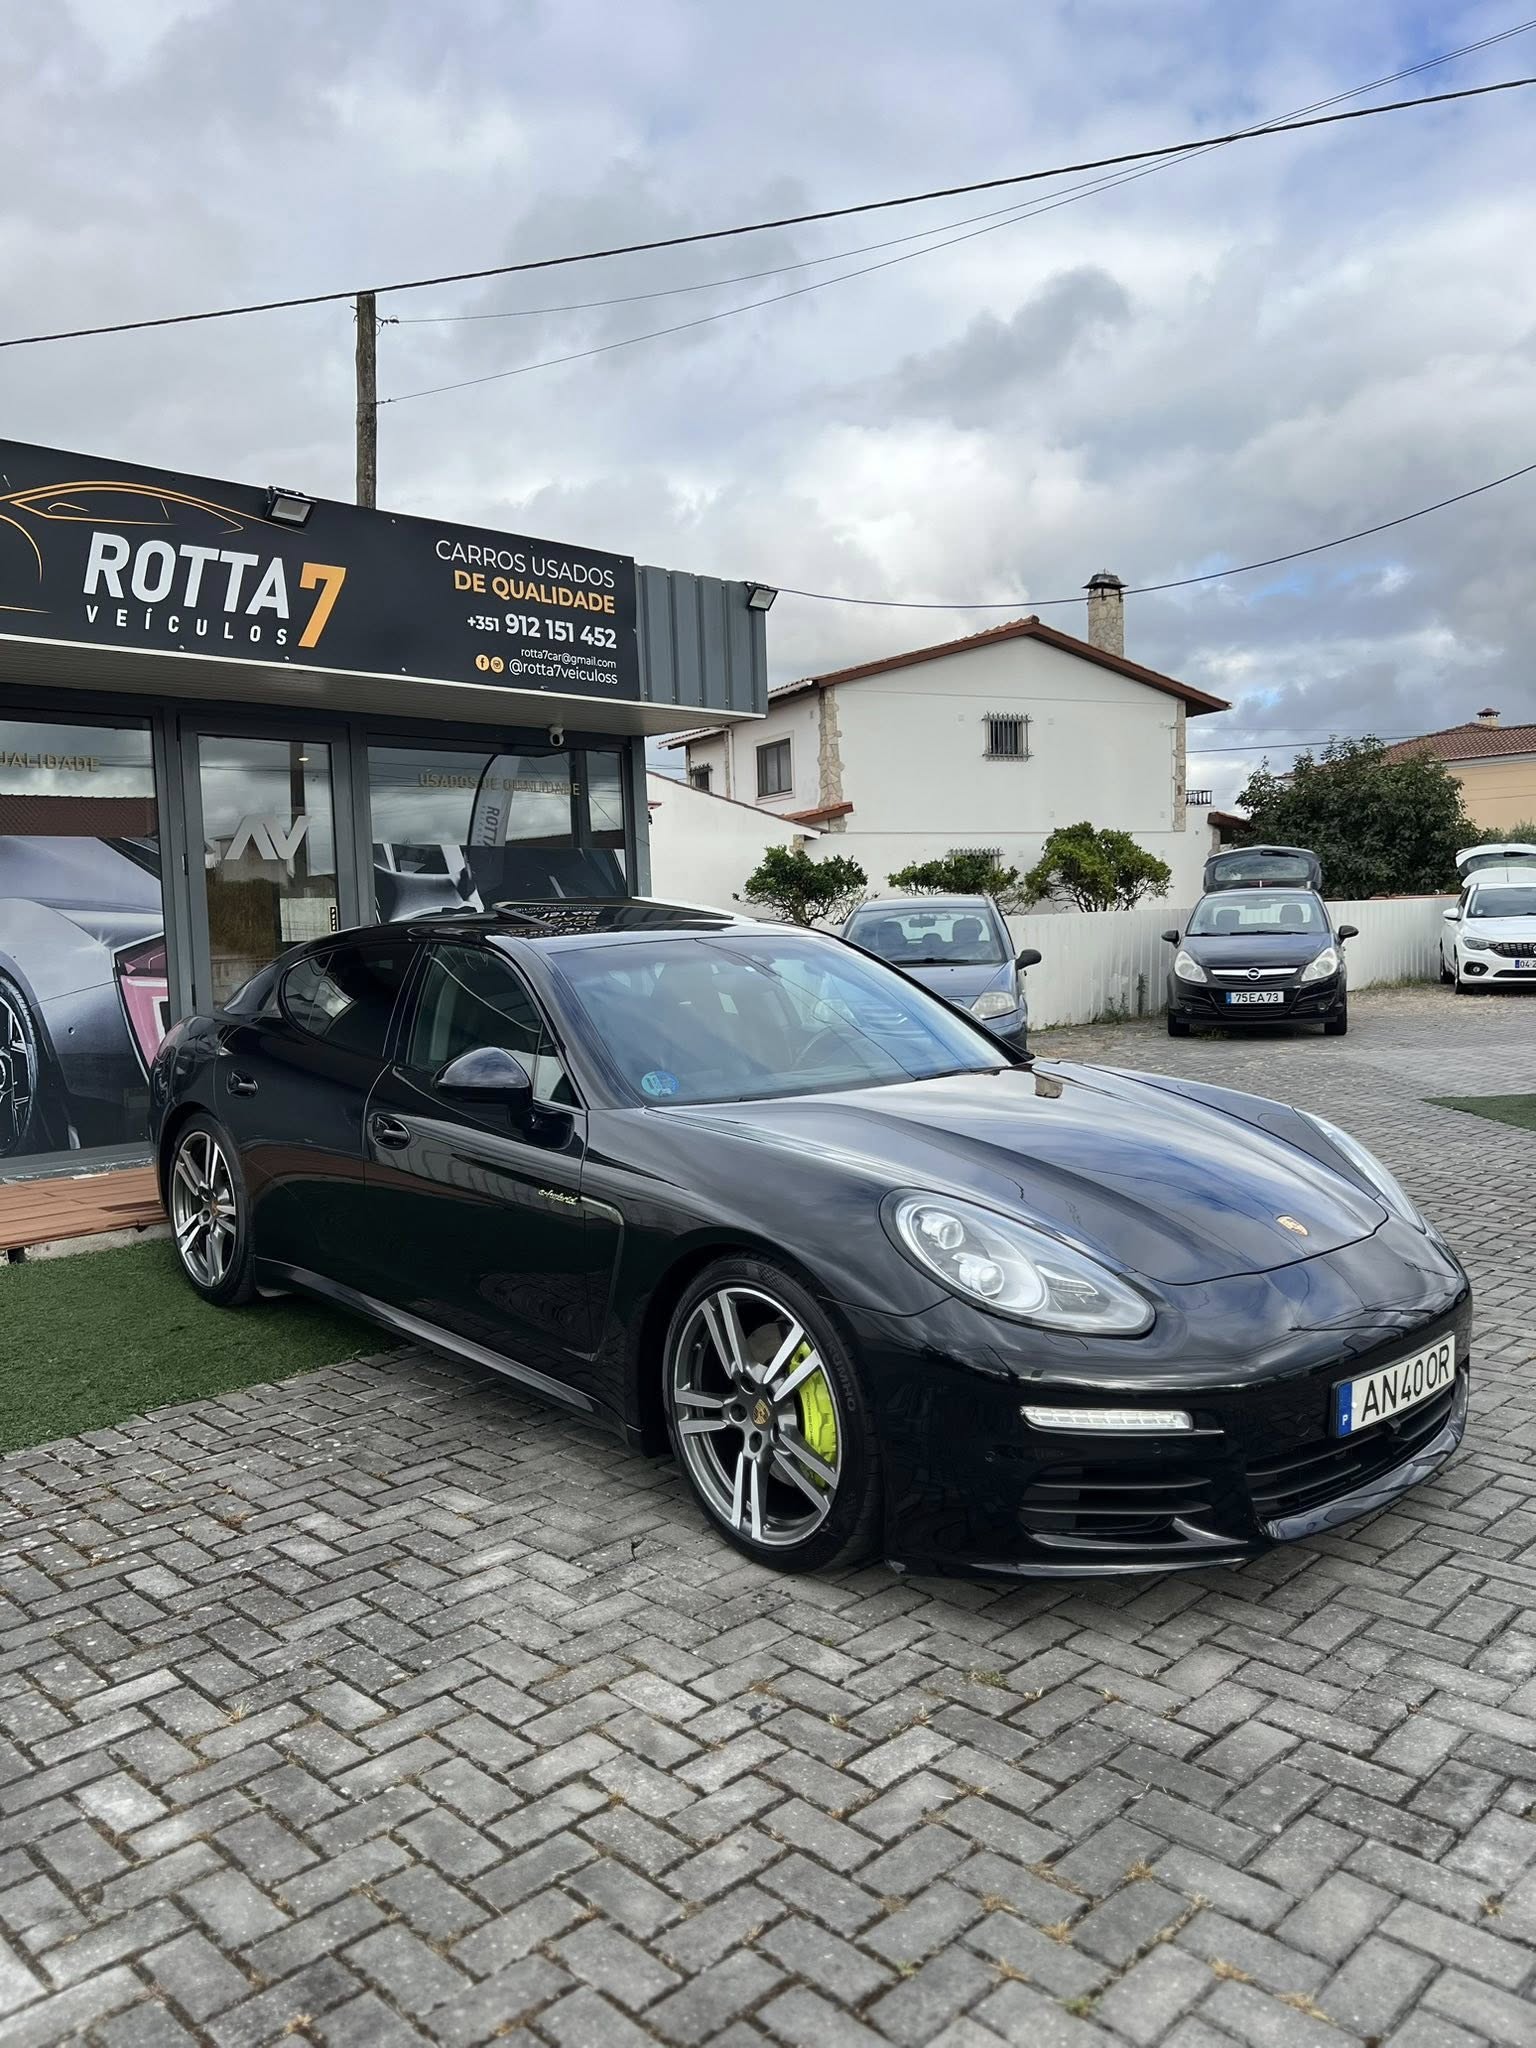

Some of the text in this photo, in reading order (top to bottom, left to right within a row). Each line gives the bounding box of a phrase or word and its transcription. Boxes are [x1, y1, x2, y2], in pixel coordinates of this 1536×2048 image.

[435, 540, 615, 588] CARROS USADOS
[454, 569, 616, 615] DE QUALIDADE
[86, 605, 288, 646] VEÍCULOS
[467, 613, 617, 649] +351 912 151 452
[509, 658, 618, 685] @rotta7veiculoss
[521, 648, 617, 669] rotta7car@gmail.com
[1235, 993, 1279, 1003] 75EA73
[1342, 1414, 1349, 1426] P
